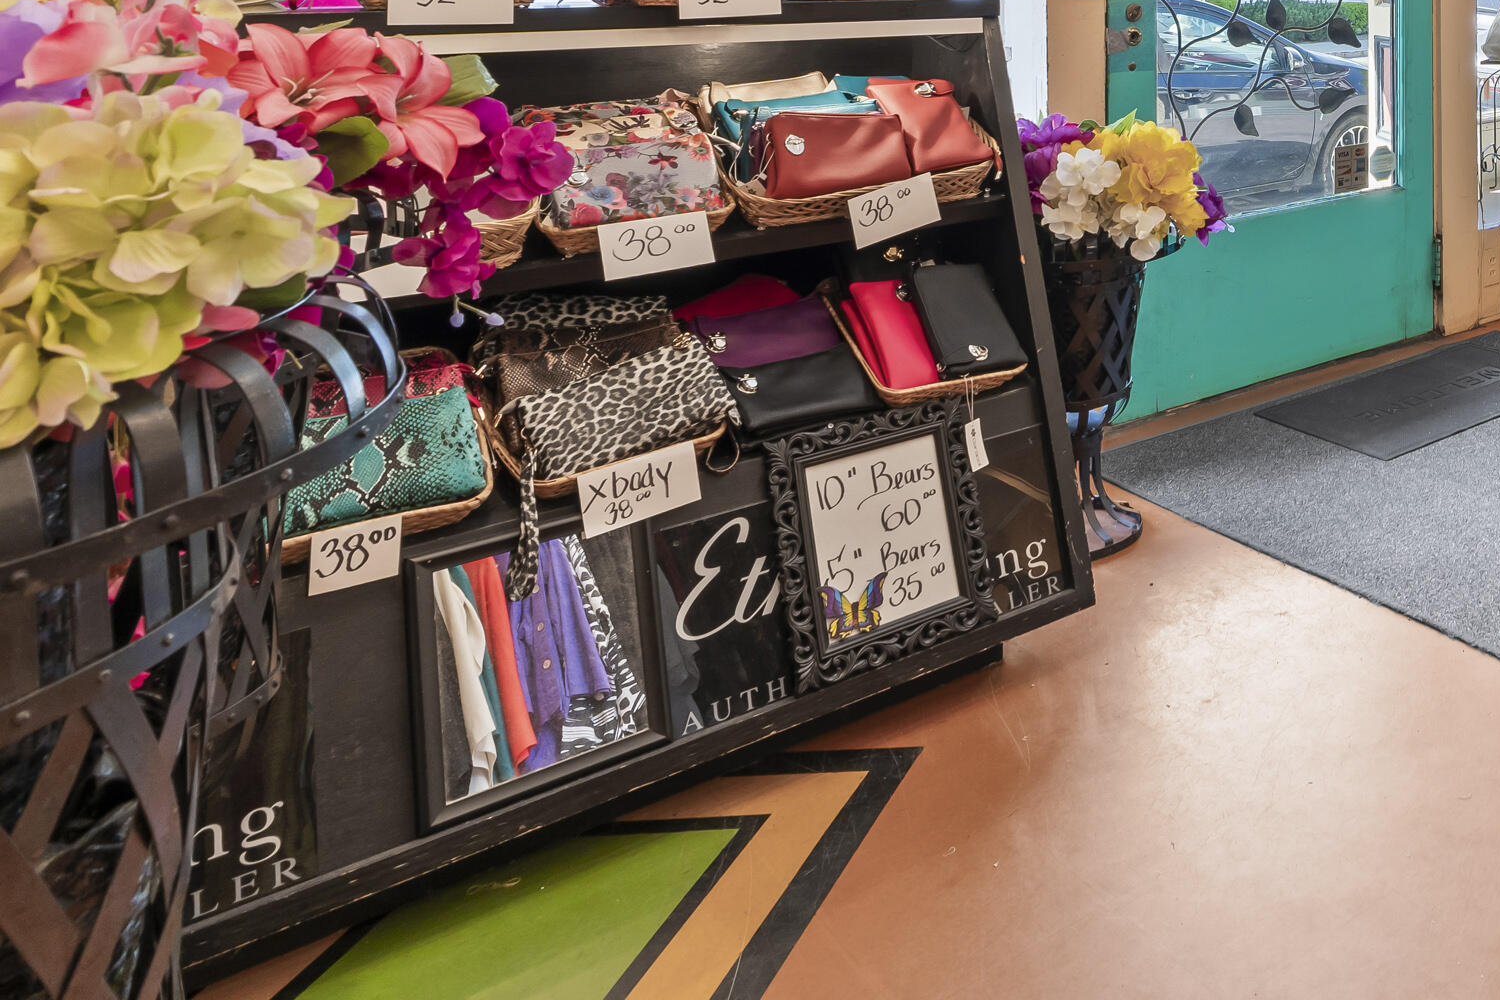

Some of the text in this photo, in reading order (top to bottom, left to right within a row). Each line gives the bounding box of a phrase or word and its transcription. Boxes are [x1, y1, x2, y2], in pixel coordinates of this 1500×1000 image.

[858, 461, 935, 510] Bears
[880, 541, 941, 572] Bears
[986, 538, 1047, 580] ng
[682, 677, 788, 736] AUTH
